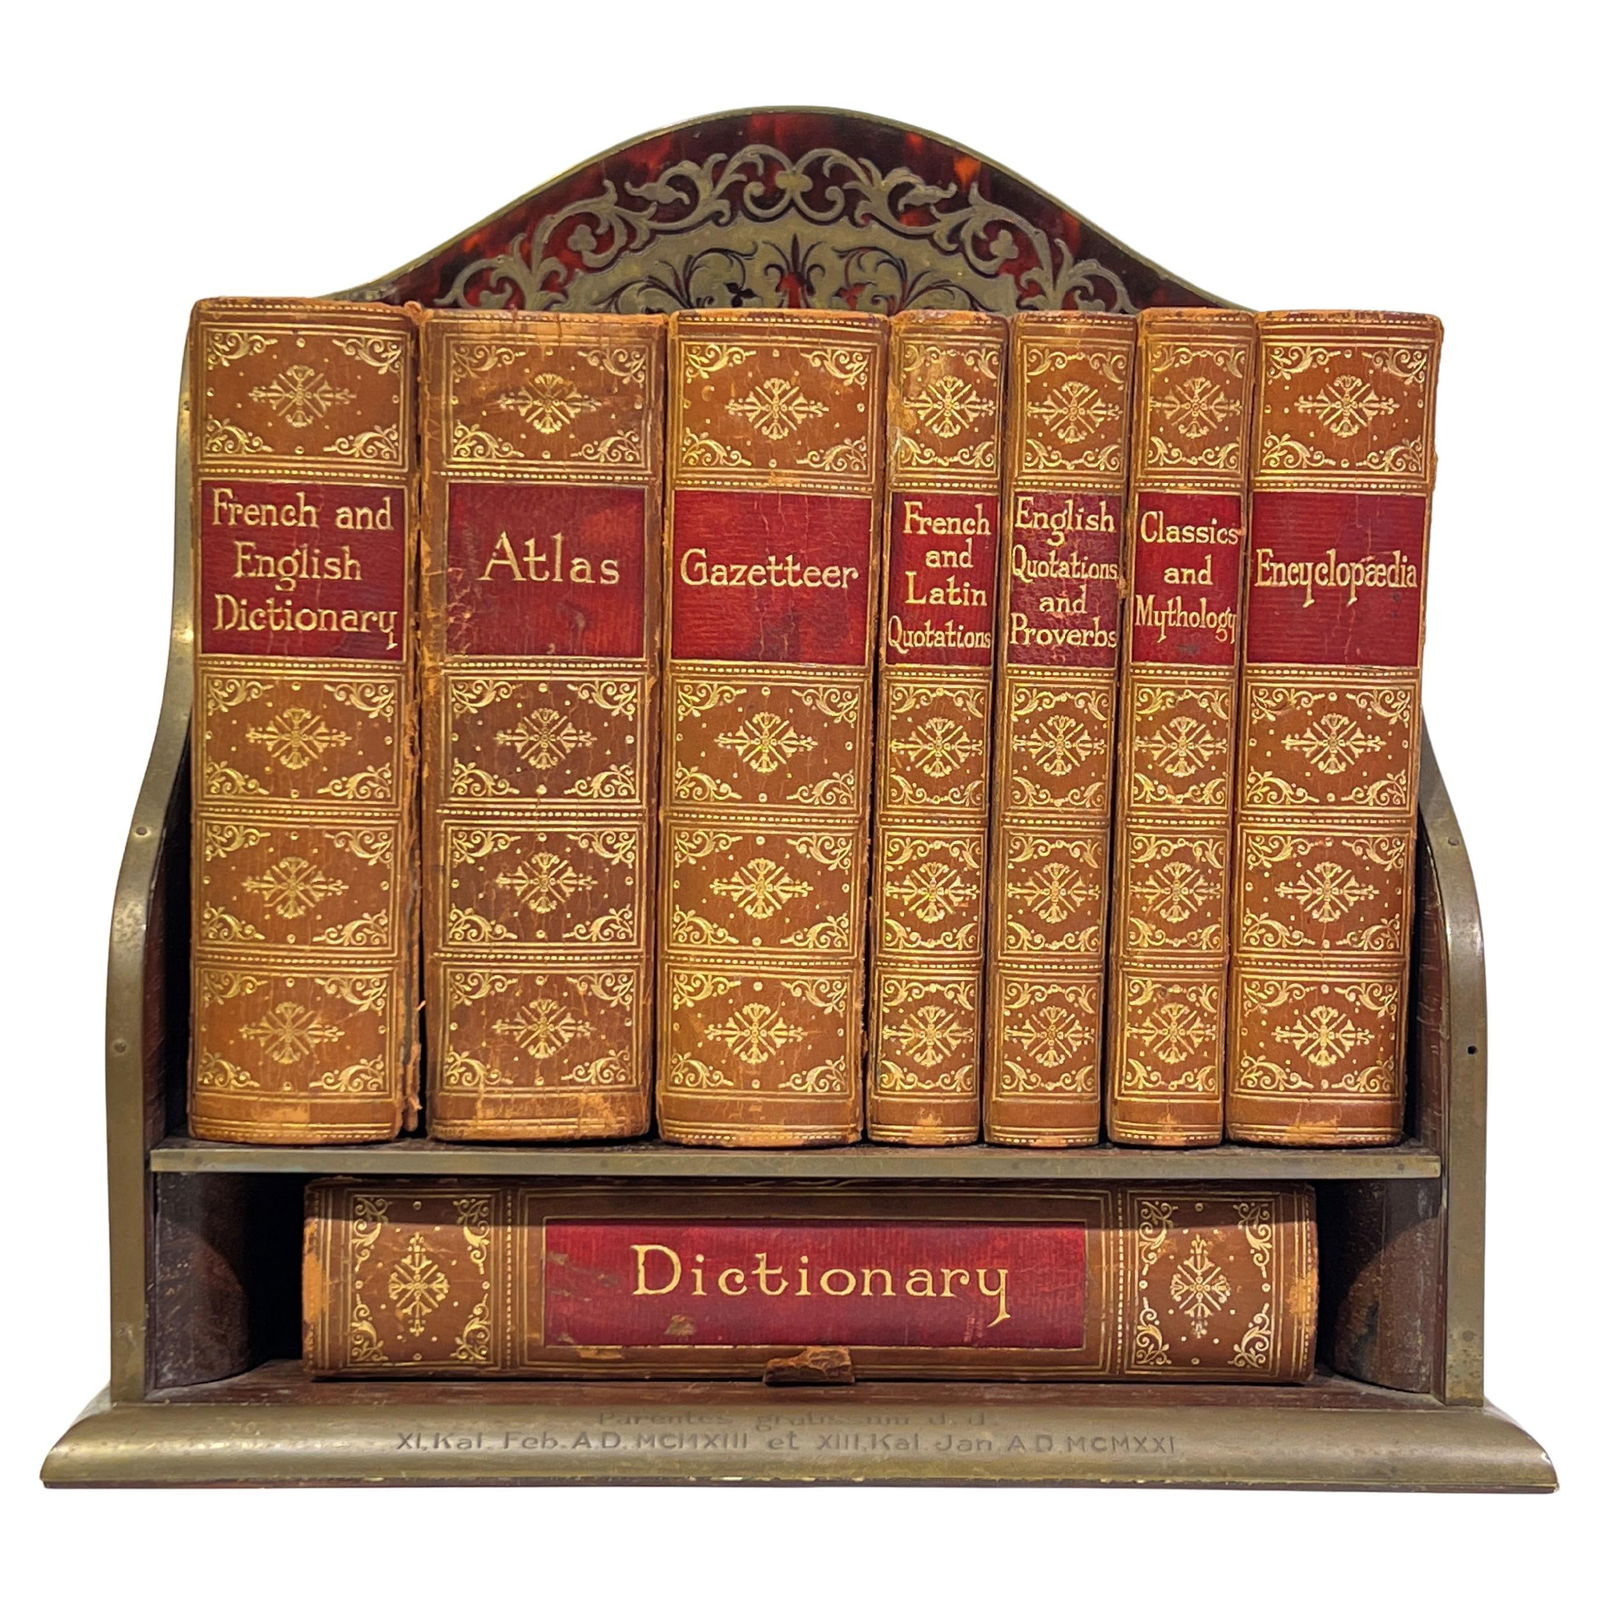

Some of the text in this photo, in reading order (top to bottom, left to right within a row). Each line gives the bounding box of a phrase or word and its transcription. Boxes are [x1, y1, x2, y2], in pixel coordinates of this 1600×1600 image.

[212, 488, 395, 531] French and
[903, 501, 991, 536] French
[1013, 497, 1116, 546] English
[1140, 510, 1240, 545] Classics
[233, 541, 363, 592] English
[479, 531, 620, 585] Atlas
[680, 547, 859, 590] Gazetteer
[925, 538, 974, 569] and
[1011, 544, 1119, 583] Quotations
[1164, 555, 1213, 586] and
[904, 570, 987, 607] Latin
[1039, 585, 1088, 615] and
[213, 594, 398, 651] Dictionary
[888, 615, 991, 654] Quotations
[1009, 613, 1117, 649] Proverbs
[1135, 595, 1237, 644] Mythology
[631, 1244, 1011, 1328] Dictionary
[599, 1411, 734, 1426] Parentes
[767, 1430, 799, 1451] et
